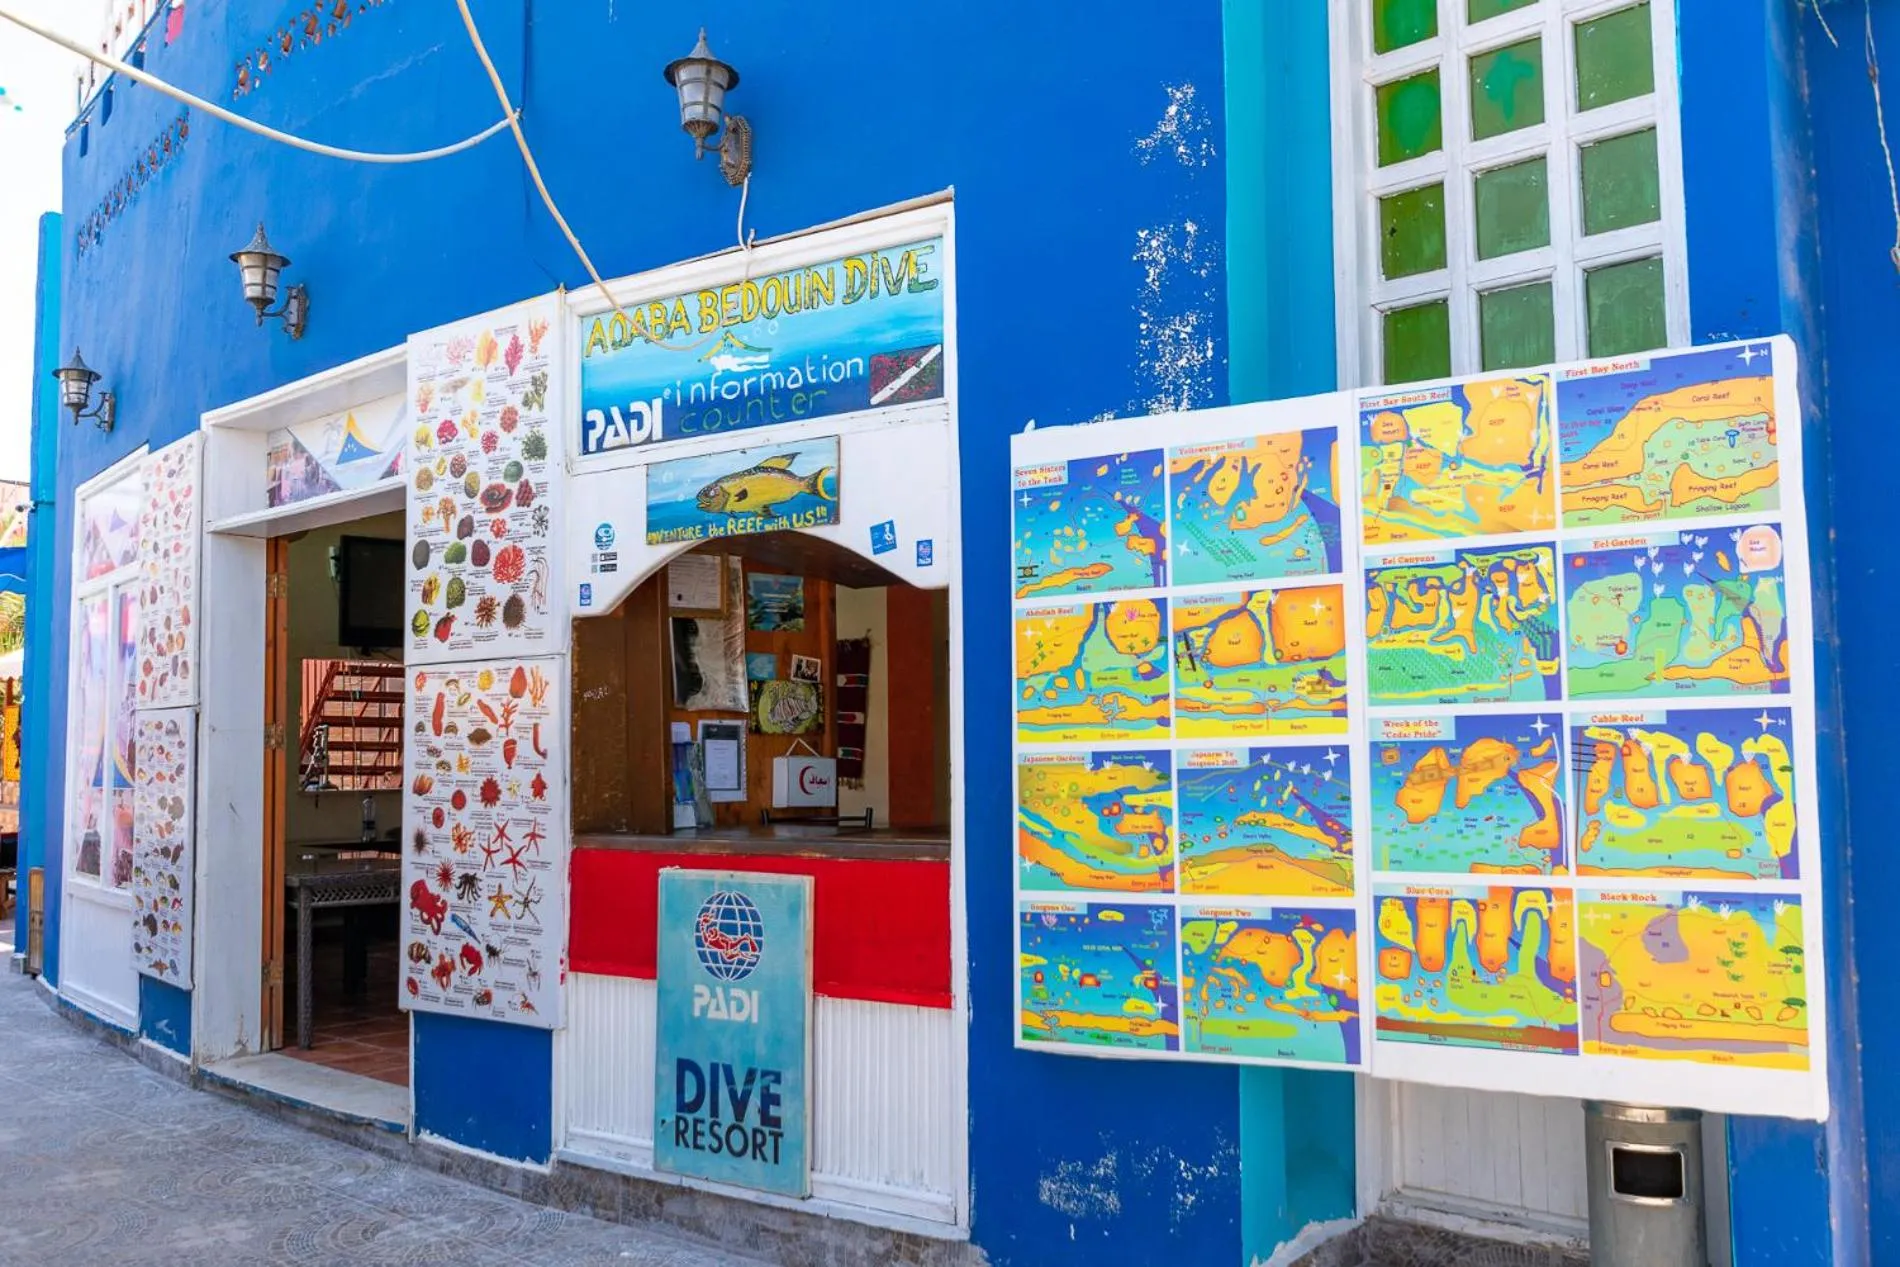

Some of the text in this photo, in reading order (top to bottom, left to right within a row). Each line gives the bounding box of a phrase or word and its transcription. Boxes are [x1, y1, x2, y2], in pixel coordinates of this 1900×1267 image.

[698, 266, 836, 333] BEDOUIN
[842, 246, 938, 305] DIVE
[1565, 360, 1640, 377] First Bay North
[586, 355, 864, 452] PADI information
[680, 389, 828, 434] counter
[1360, 400, 1380, 409] First
[709, 524, 725, 538] the
[727, 517, 762, 535] REEF
[764, 517, 789, 531] with
[1593, 538, 1647, 549] Eel Garden
[1591, 714, 1644, 723] Cable Reef
[1600, 893, 1628, 901] Black
[693, 984, 759, 1024] PADI
[676, 1057, 782, 1130] DIVE
[675, 1115, 785, 1165] RESORT
